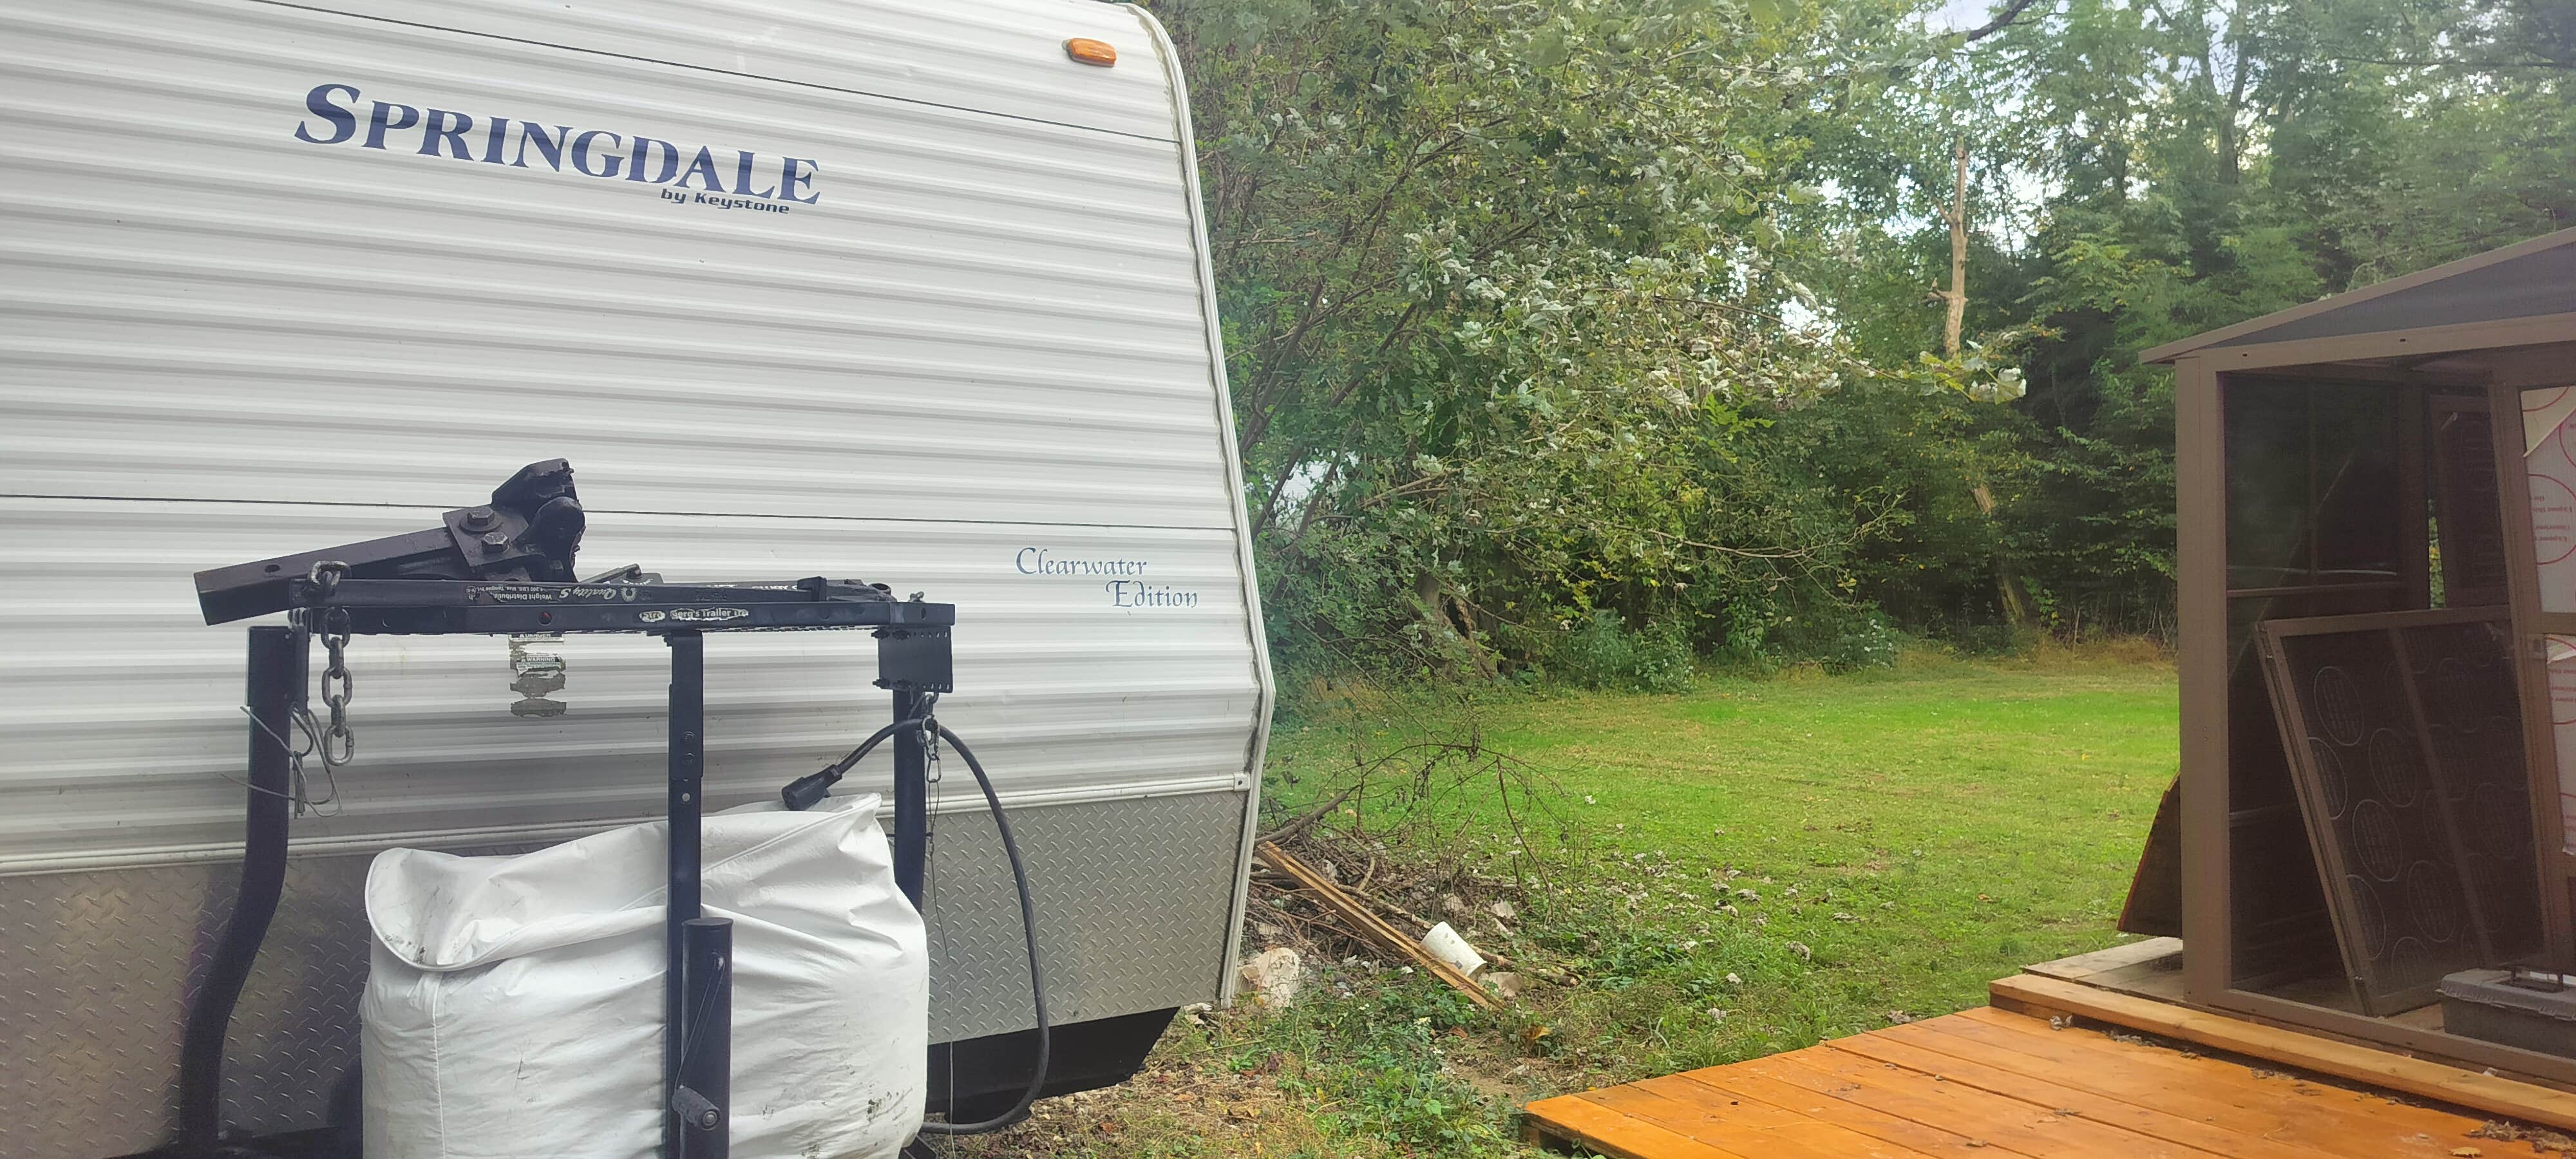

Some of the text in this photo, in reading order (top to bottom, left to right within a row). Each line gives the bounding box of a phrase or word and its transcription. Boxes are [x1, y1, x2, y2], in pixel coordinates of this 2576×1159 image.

[294, 83, 821, 205] SPRINGDALE
[661, 188, 790, 214] by Keystone
[1016, 547, 1148, 575] Clearwater
[573, 586, 617, 600] Quality
[1105, 580, 1198, 608] Edition
